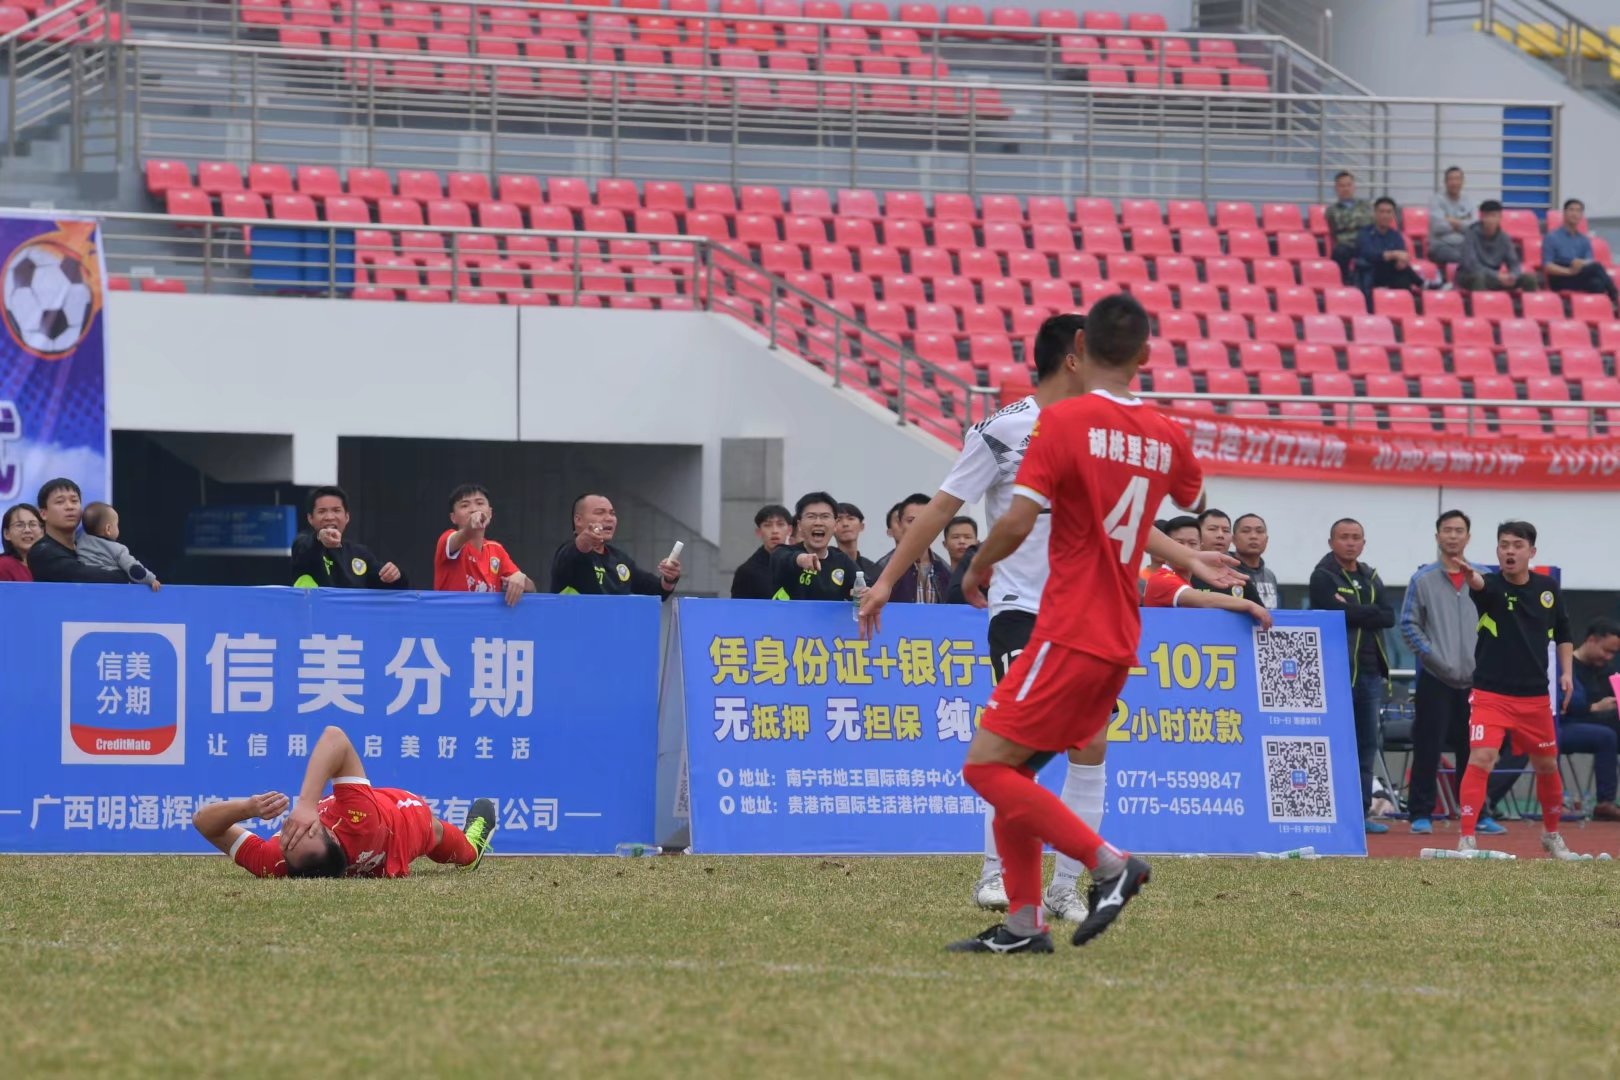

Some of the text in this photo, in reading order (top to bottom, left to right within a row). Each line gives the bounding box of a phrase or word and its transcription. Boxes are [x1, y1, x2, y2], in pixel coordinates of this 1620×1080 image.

[1103, 475, 1149, 564] 4
[96, 651, 151, 681] 信美
[205, 632, 535, 717] 信美分期
[96, 685, 151, 715] 分期
[714, 697, 811, 742] 无抵押
[826, 697, 922, 742] 无担保
[1470, 724, 1484, 741] 18
[95, 738, 151, 751] CreditMate
[207, 733, 530, 760] 让信用启美好生活
[1117, 770, 1242, 789] 0771-5599847
[1118, 797, 1245, 816] 0775-4554446
